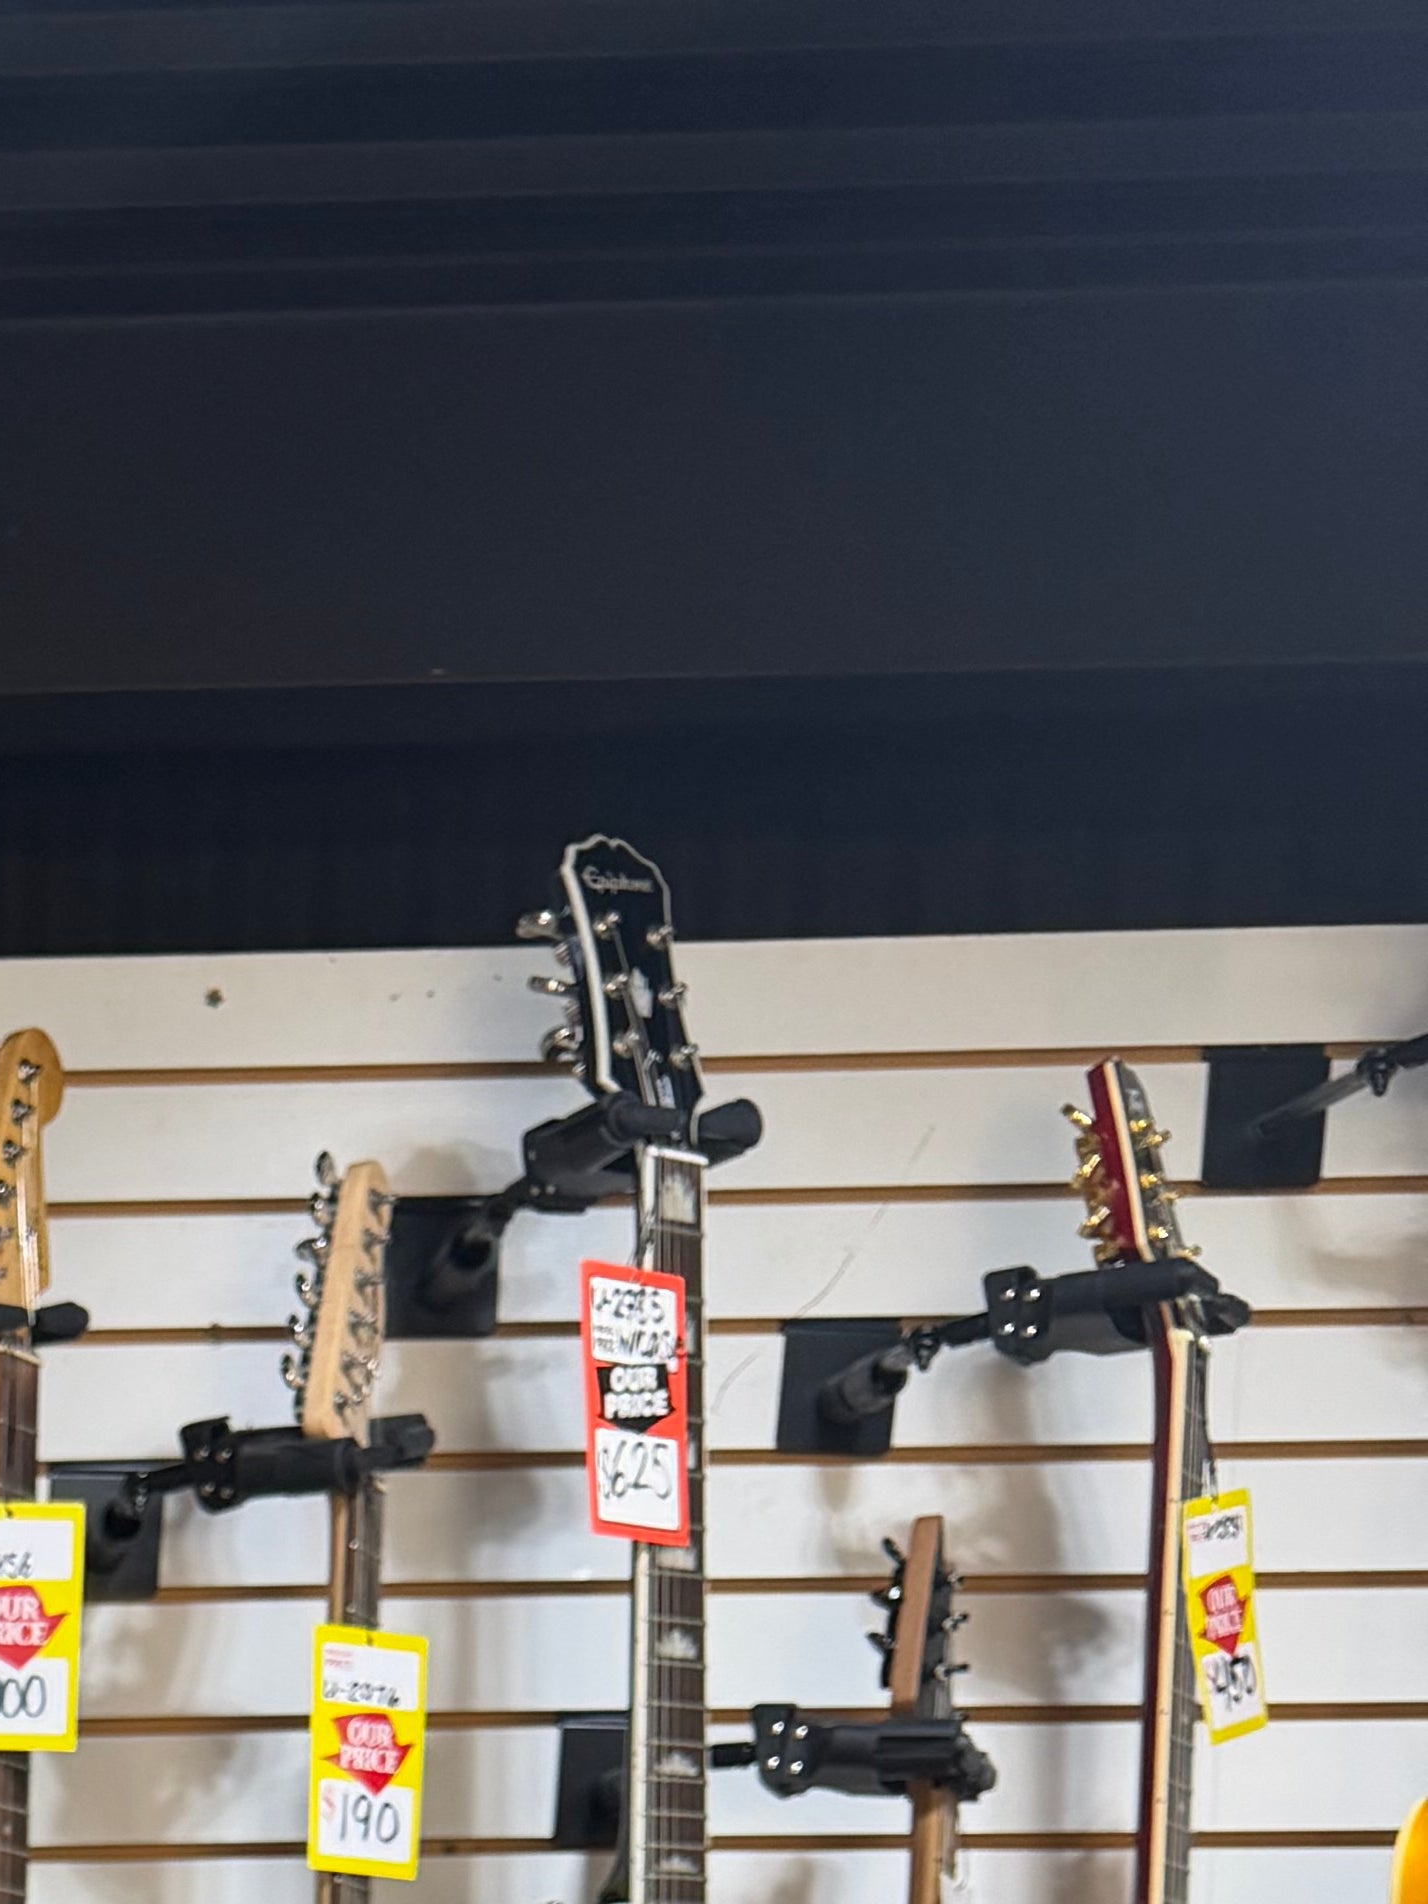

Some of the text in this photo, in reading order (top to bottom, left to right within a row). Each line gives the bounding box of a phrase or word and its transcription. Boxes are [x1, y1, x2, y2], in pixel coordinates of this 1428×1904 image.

[609, 1365, 659, 1393] OUR
[603, 1390, 671, 1420] PRICE
[598, 1439, 673, 1500] $625
[346, 1715, 394, 1748] OUR
[339, 1744, 400, 1775] PRICE
